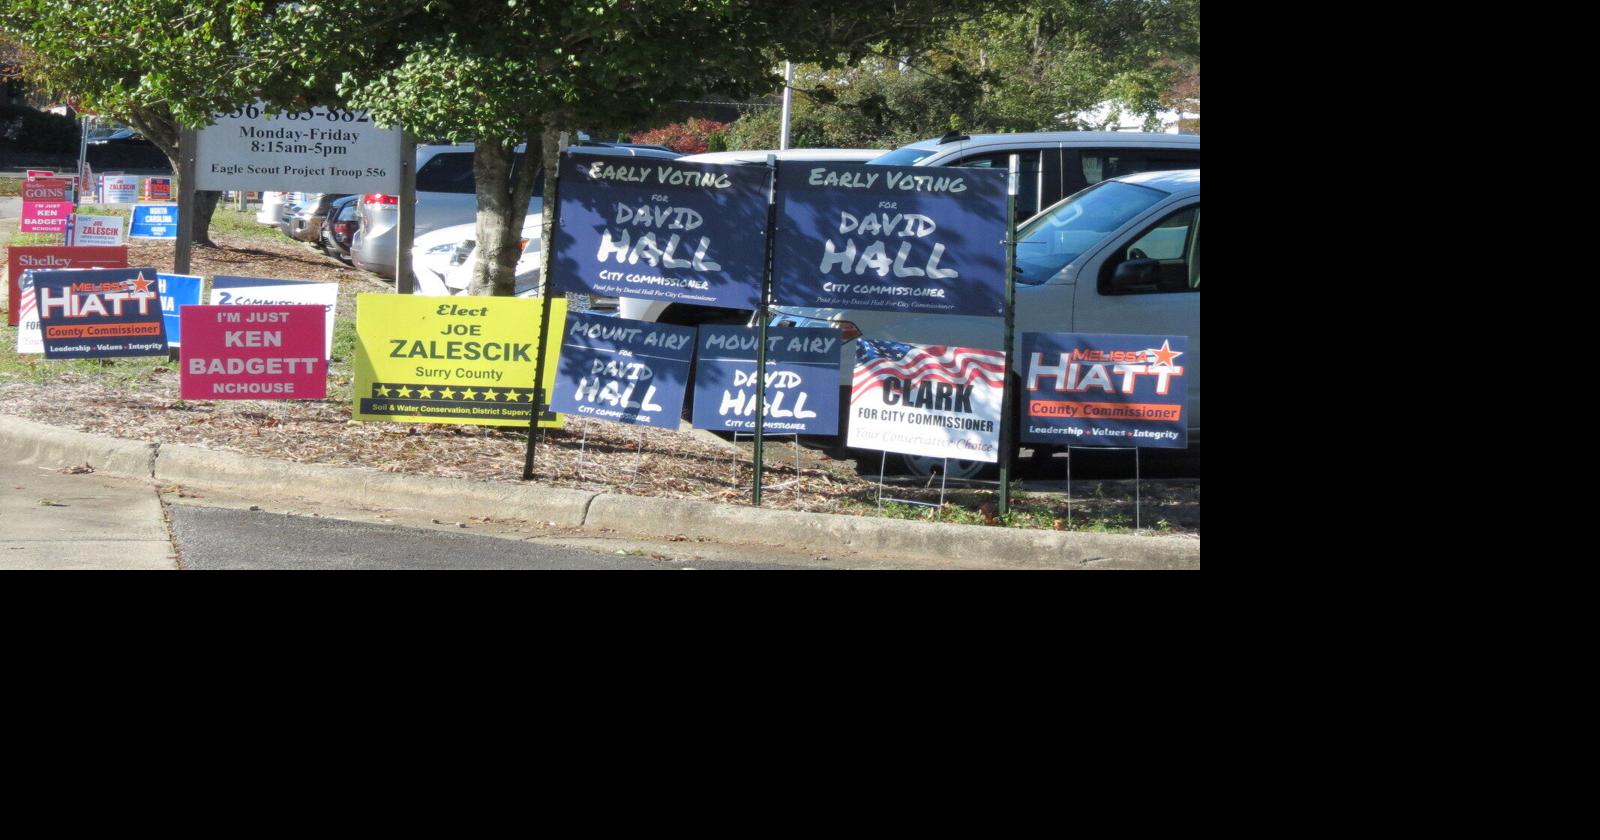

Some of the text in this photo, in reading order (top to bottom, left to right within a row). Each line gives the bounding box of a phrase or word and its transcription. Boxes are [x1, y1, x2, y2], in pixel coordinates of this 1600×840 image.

[239, 126, 361, 144] Monday-Friday
[250, 141, 347, 157] 8:15am-5pm
[211, 163, 386, 178] Eagle Scout Project Troop 556
[588, 161, 732, 189] EARLY VOTING
[808, 167, 967, 193] EARLY VOTING
[25, 189, 63, 198] GOINS
[651, 194, 668, 203] FOR
[879, 201, 898, 209] FOR
[616, 202, 703, 231] DAVID
[839, 211, 937, 238] DAVID
[82, 226, 118, 235] ZALESCIK
[596, 228, 722, 272] HALL
[19, 255, 72, 267] Shelley
[819, 239, 958, 279] HALL
[70, 282, 128, 292] MELISSA
[626, 274, 709, 290] COMMISSIONER
[219, 292, 232, 305] 2
[853, 284, 945, 298] COMMISSIONER
[40, 286, 156, 318] HIATT
[217, 312, 290, 323] I'M JUST
[436, 304, 488, 317] Elect
[48, 325, 158, 338] County Commissioner
[440, 324, 482, 336] JOE
[570, 320, 690, 350] MOUNT AIRY
[225, 331, 281, 347] KEN
[705, 334, 836, 353] MOUT AIRY
[389, 339, 532, 362] ZALESCIK
[1073, 348, 1149, 362] MELISSA
[189, 358, 318, 375] BADGETT
[415, 366, 503, 381] Surry County
[591, 358, 653, 381] DAVID
[1026, 352, 1184, 395] HIATT
[213, 383, 294, 393] NCHOUSE
[575, 376, 662, 412] HALL
[882, 376, 974, 413] CLARK
[397, 404, 418, 412] Water
[472, 407, 500, 415] District
[1031, 402, 1177, 418] County Commissioner
[745, 420, 807, 430] COMISSIONER
[858, 407, 994, 433] FOR CITY COMMISSIONER
[1029, 425, 1179, 440] Leadership Values Integrity
[956, 438, 993, 452] Choice
